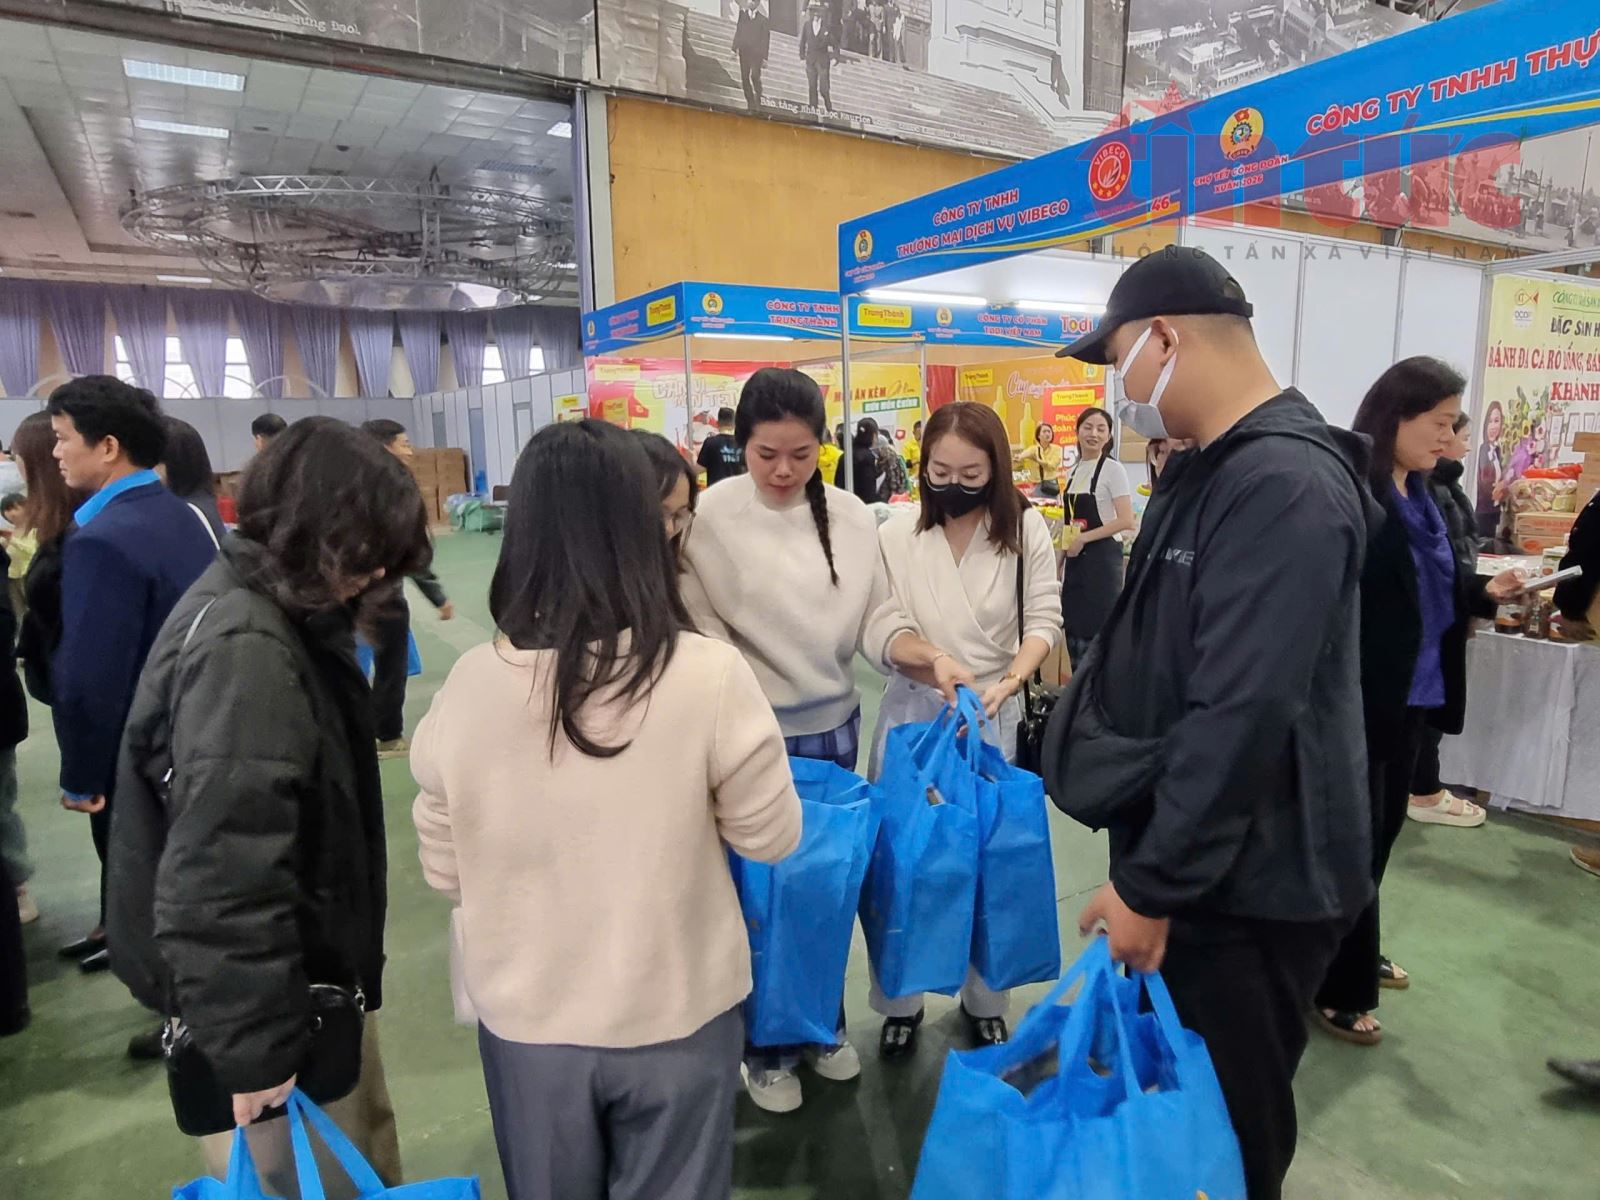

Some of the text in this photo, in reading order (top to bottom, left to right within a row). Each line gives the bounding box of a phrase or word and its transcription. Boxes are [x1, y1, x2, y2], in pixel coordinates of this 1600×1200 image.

[1306, 98, 1380, 136] CÔNG
[1387, 84, 1424, 113] TY
[1429, 58, 1518, 102] TNHH
[1094, 146, 1126, 166] VIBECO
[1231, 162, 1258, 177] CÔNG
[933, 188, 1019, 226] CÔNG TY TNHH
[1151, 195, 1170, 212] 46
[941, 227, 964, 247] MẠI
[965, 220, 994, 241] DỊCH
[997, 214, 1015, 233] VỤ
[1018, 199, 1070, 224] VIBECO
[766, 298, 796, 311] CÔNG
[797, 301, 811, 312] TY
[1488, 340, 1517, 368] BÁNH
